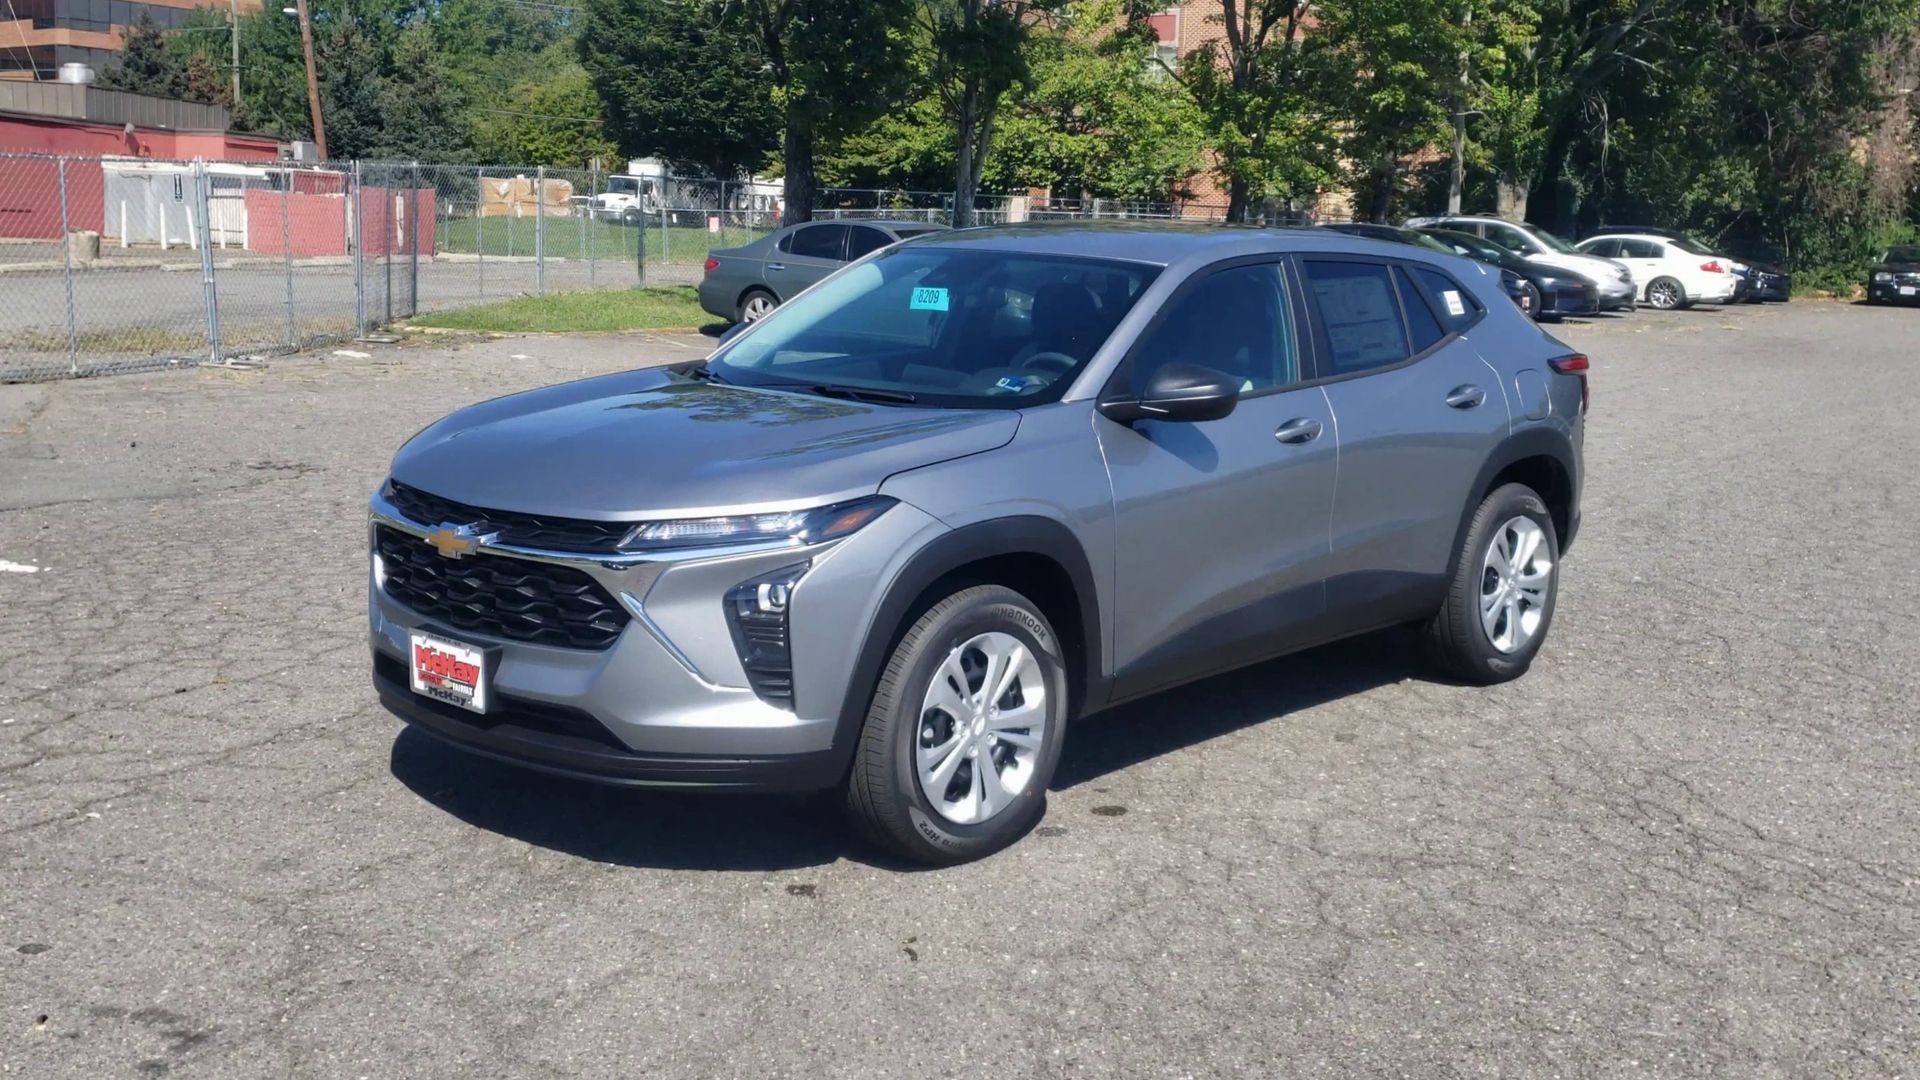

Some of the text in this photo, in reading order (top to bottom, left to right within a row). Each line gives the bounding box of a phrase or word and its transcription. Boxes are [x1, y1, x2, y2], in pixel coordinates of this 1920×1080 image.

[918, 289, 940, 304] 8209
[415, 644, 480, 689] McKay
[428, 686, 467, 707] McKay
